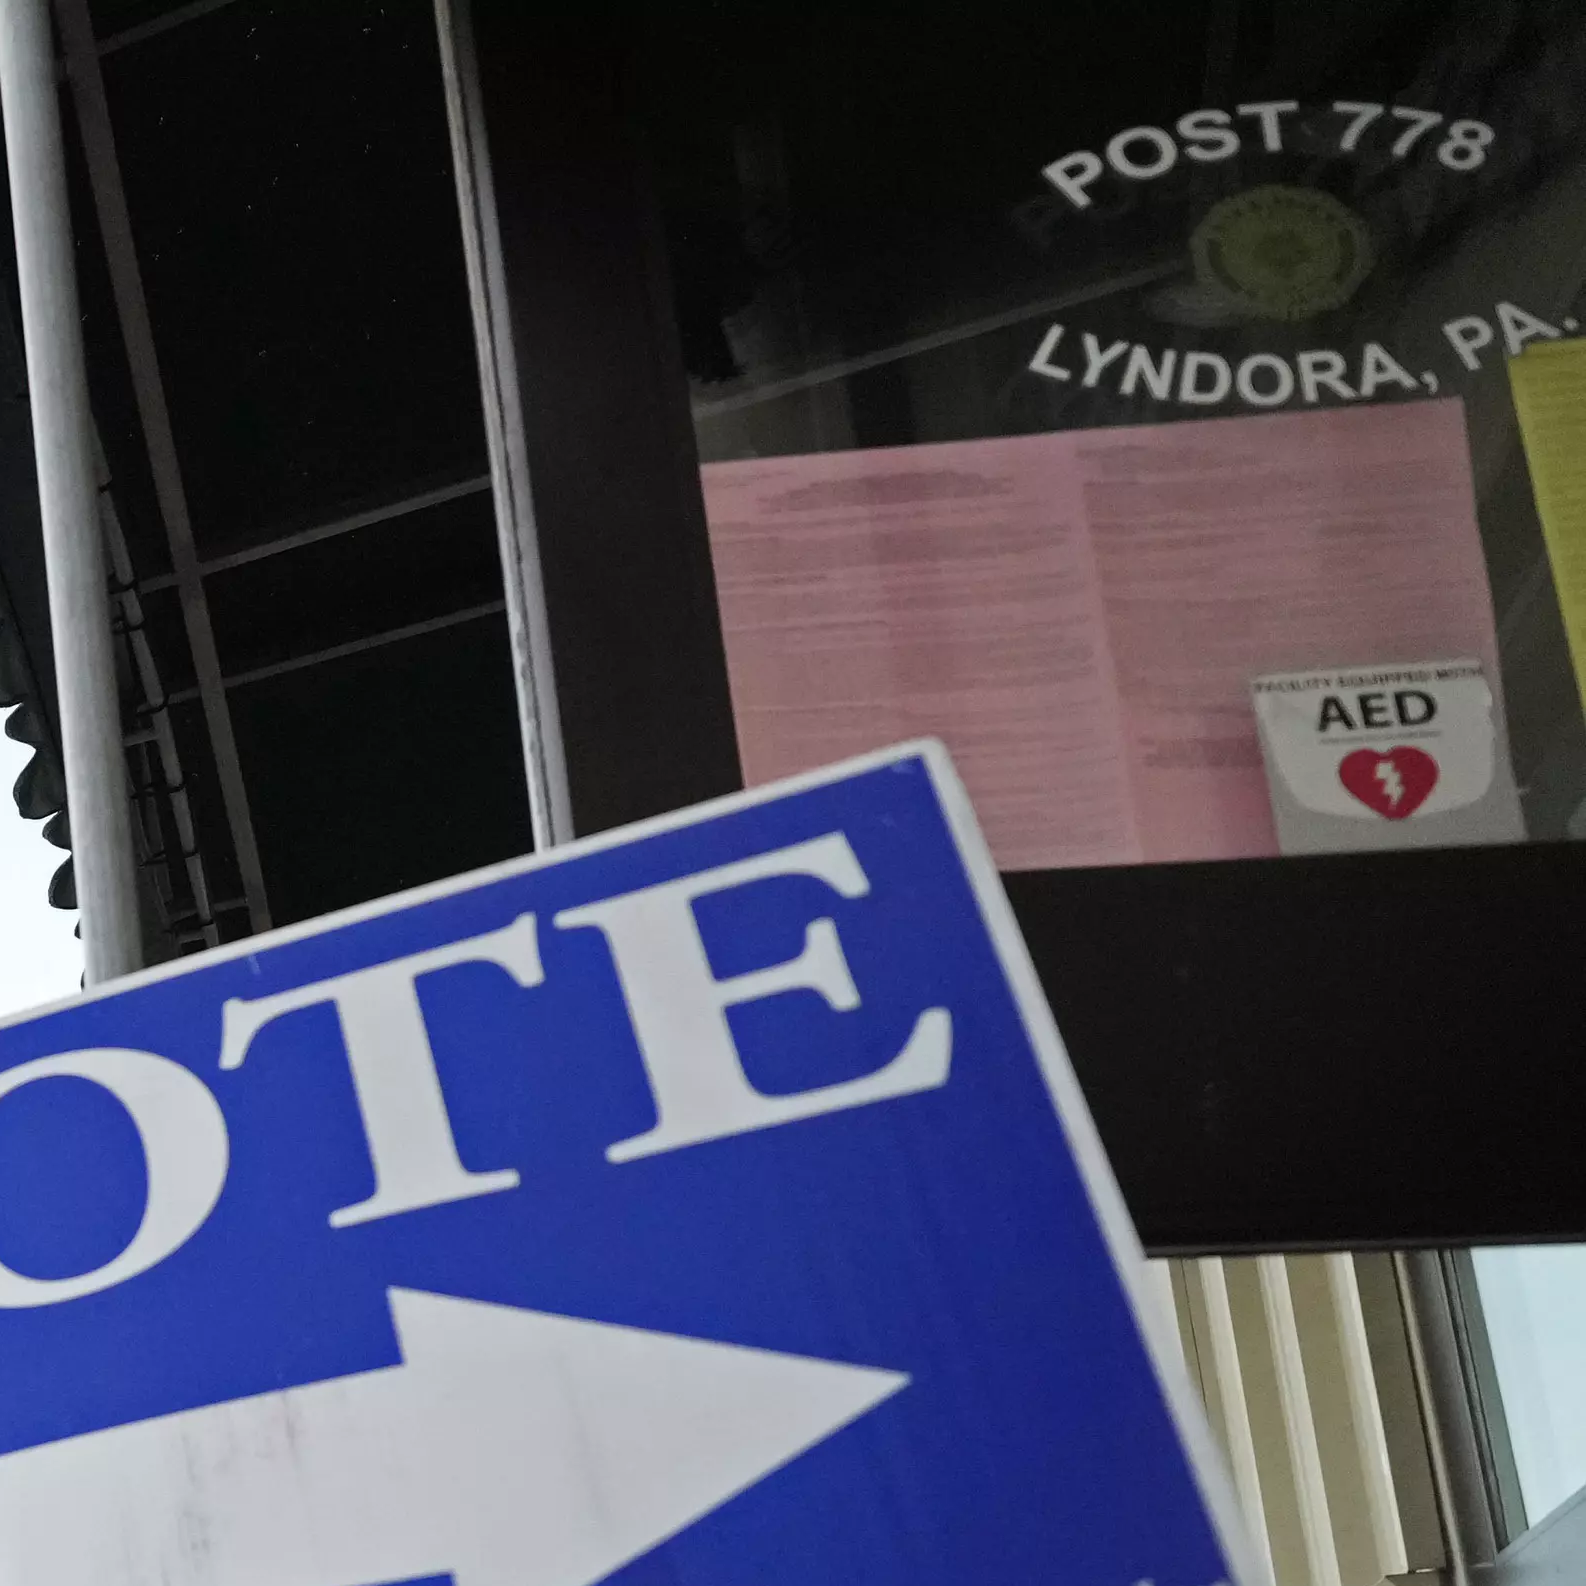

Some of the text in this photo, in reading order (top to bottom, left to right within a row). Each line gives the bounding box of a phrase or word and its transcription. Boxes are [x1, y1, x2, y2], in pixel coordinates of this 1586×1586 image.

[1042, 100, 1300, 209] POST
[1332, 101, 1496, 172] 778
[1029, 300, 1582, 406] LYNDORA, PA.
[1317, 689, 1438, 732] AED
